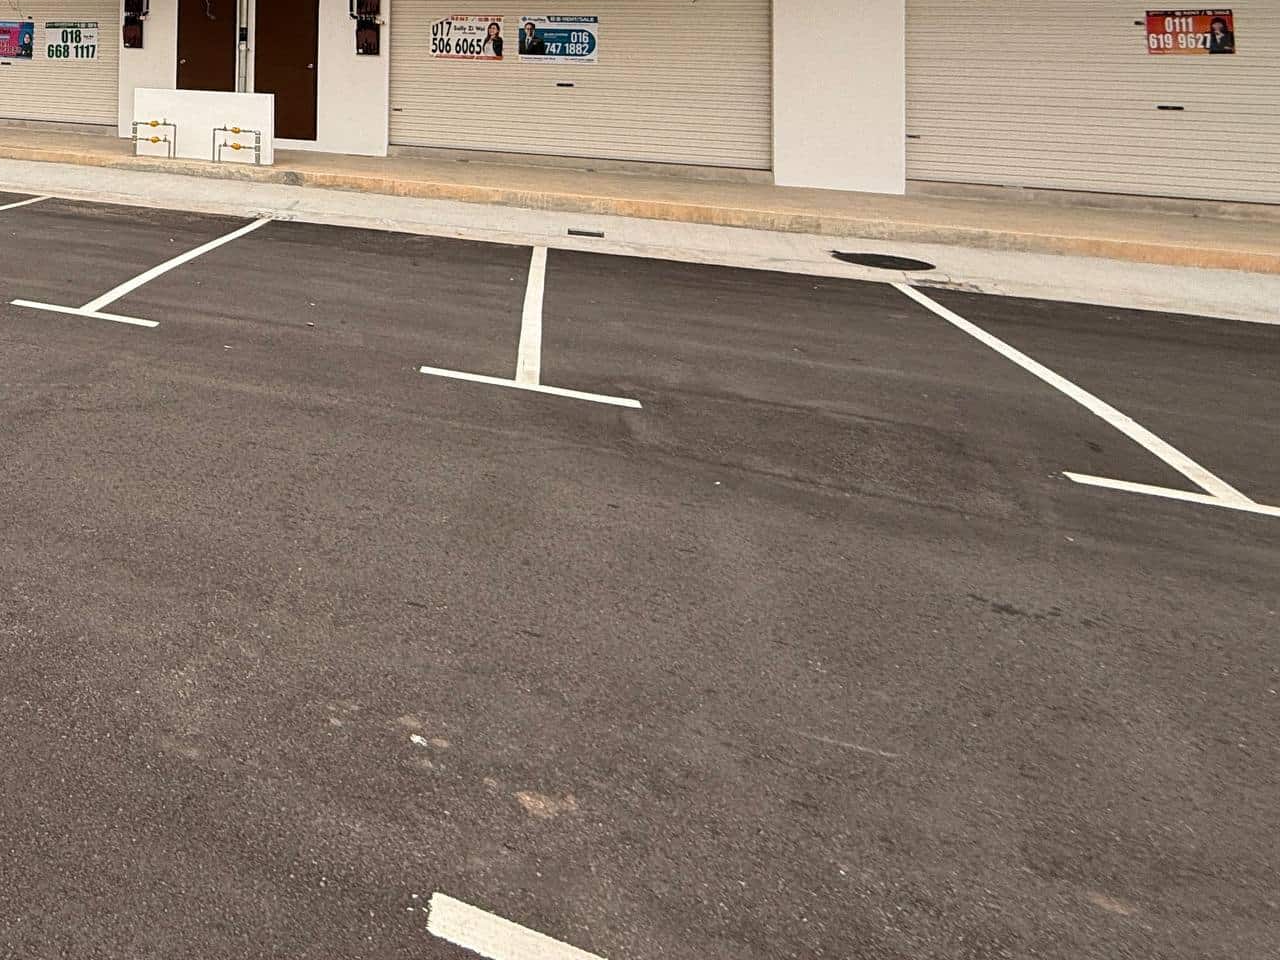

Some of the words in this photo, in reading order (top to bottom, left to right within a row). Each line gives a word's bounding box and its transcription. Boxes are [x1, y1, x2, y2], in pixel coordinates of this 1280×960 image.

[432, 21, 452, 37] 017
[1164, 17, 1193, 33] 0111
[61, 29, 82, 43] 018
[570, 32, 589, 43] 016
[1149, 34, 1173, 49] 619
[1177, 34, 1211, 49] 9627
[47, 44, 70, 58] 668
[74, 44, 96, 58] 1117
[431, 37, 451, 53] 506
[455, 38, 481, 54] 6065
[545, 43, 562, 54] 747
[565, 43, 589, 55] 1882
